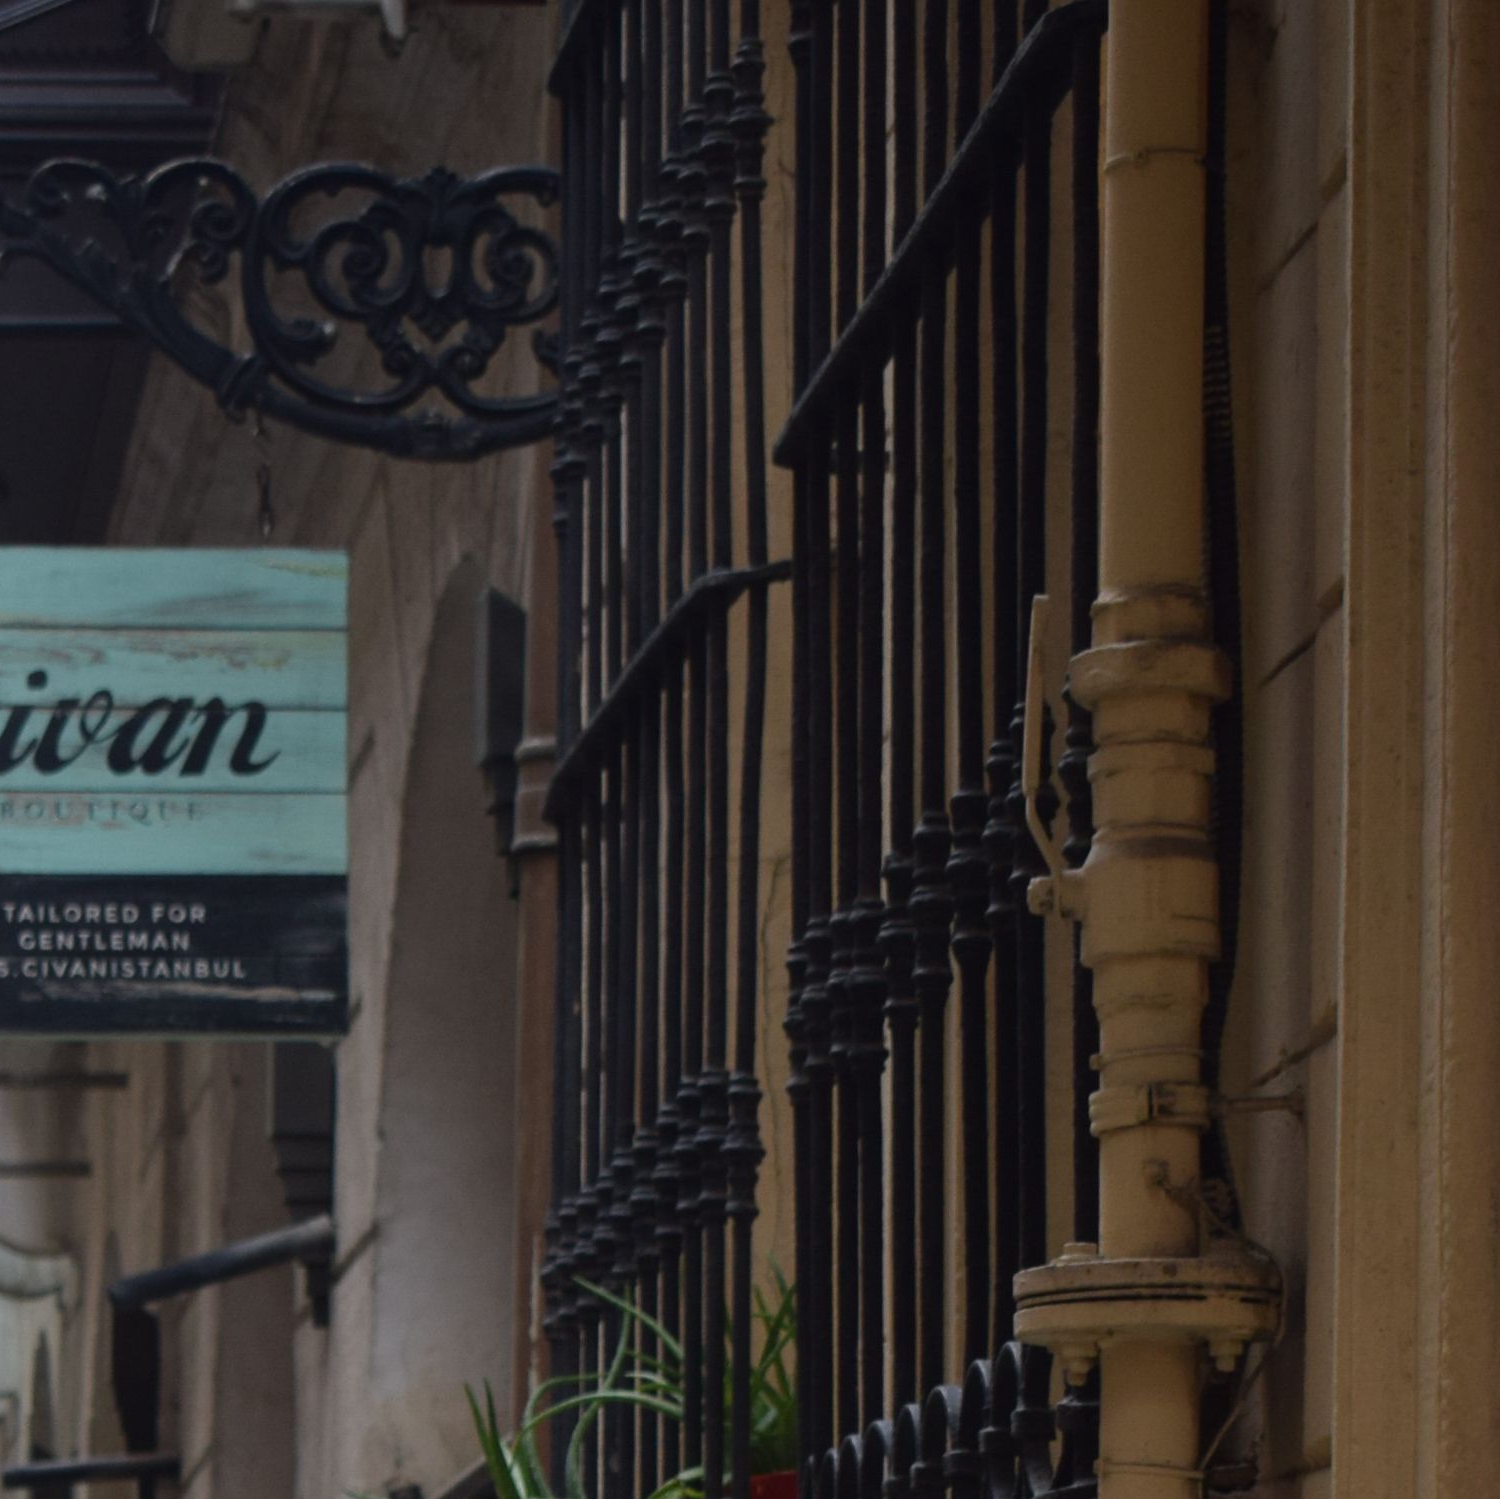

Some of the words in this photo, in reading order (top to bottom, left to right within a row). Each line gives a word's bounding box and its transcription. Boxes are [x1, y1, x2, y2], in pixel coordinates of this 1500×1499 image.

[2, 902, 140, 924] TAILORED
[151, 902, 208, 924] FOR
[17, 929, 191, 951] GENTLEMAN
